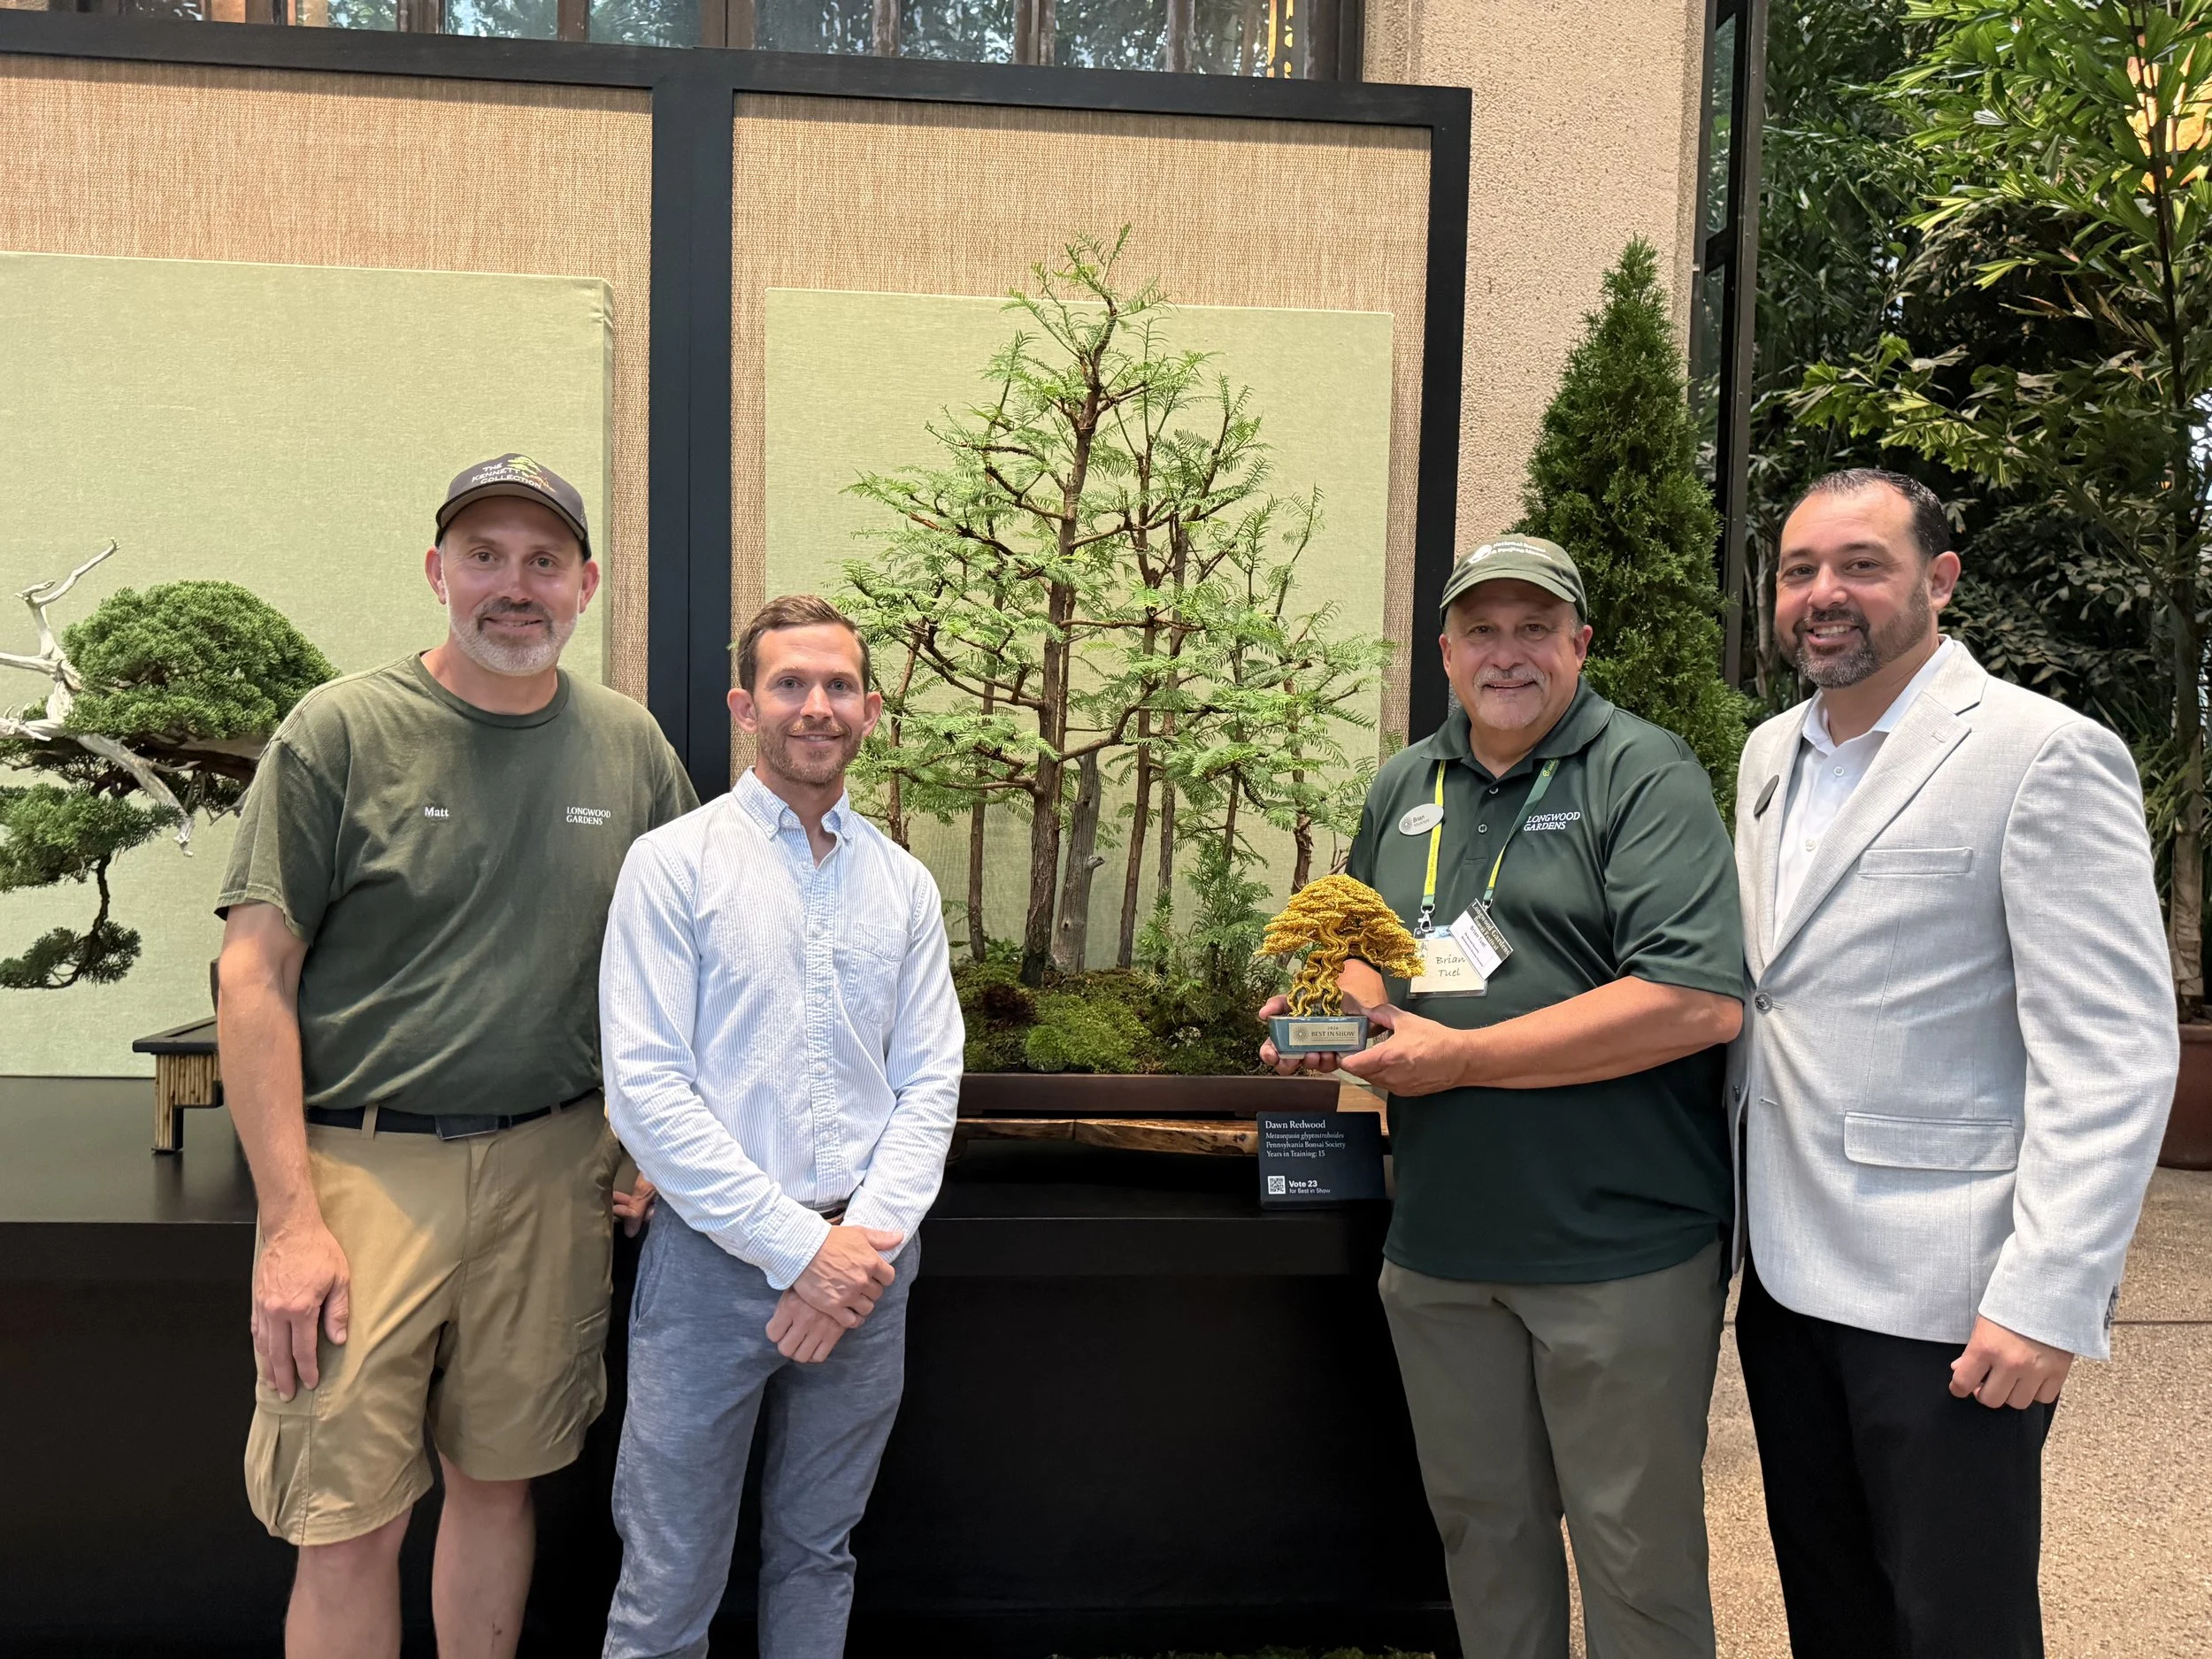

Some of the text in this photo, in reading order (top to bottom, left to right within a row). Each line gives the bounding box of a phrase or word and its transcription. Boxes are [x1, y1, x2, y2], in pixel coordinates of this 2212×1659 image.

[482, 462, 503, 472] THE
[472, 467, 521, 483] KENNETT
[480, 474, 542, 488] COLLECTION
[424, 806, 449, 818] Matt
[566, 806, 611, 818] LONGWOOD
[1526, 810, 1581, 824] LONGWOOD
[565, 815, 603, 826] GARDENS
[1412, 814, 1425, 823] Brian
[1523, 821, 1567, 832] GARDENS
[1470, 925, 1479, 939] Brian
[1471, 902, 1494, 932] Longwood
[1491, 929, 1510, 956] Gardens
[1483, 932, 1501, 950] Festival
[1435, 954, 1466, 964] Brian
[1438, 968, 1461, 978] Tuel
[1265, 1119, 1326, 1129] Dawn Redwood
[1266, 1141, 1304, 1149] Pennsylvania
[1325, 1141, 1346, 1149] Society
[1290, 1150, 1317, 1159] Training:
